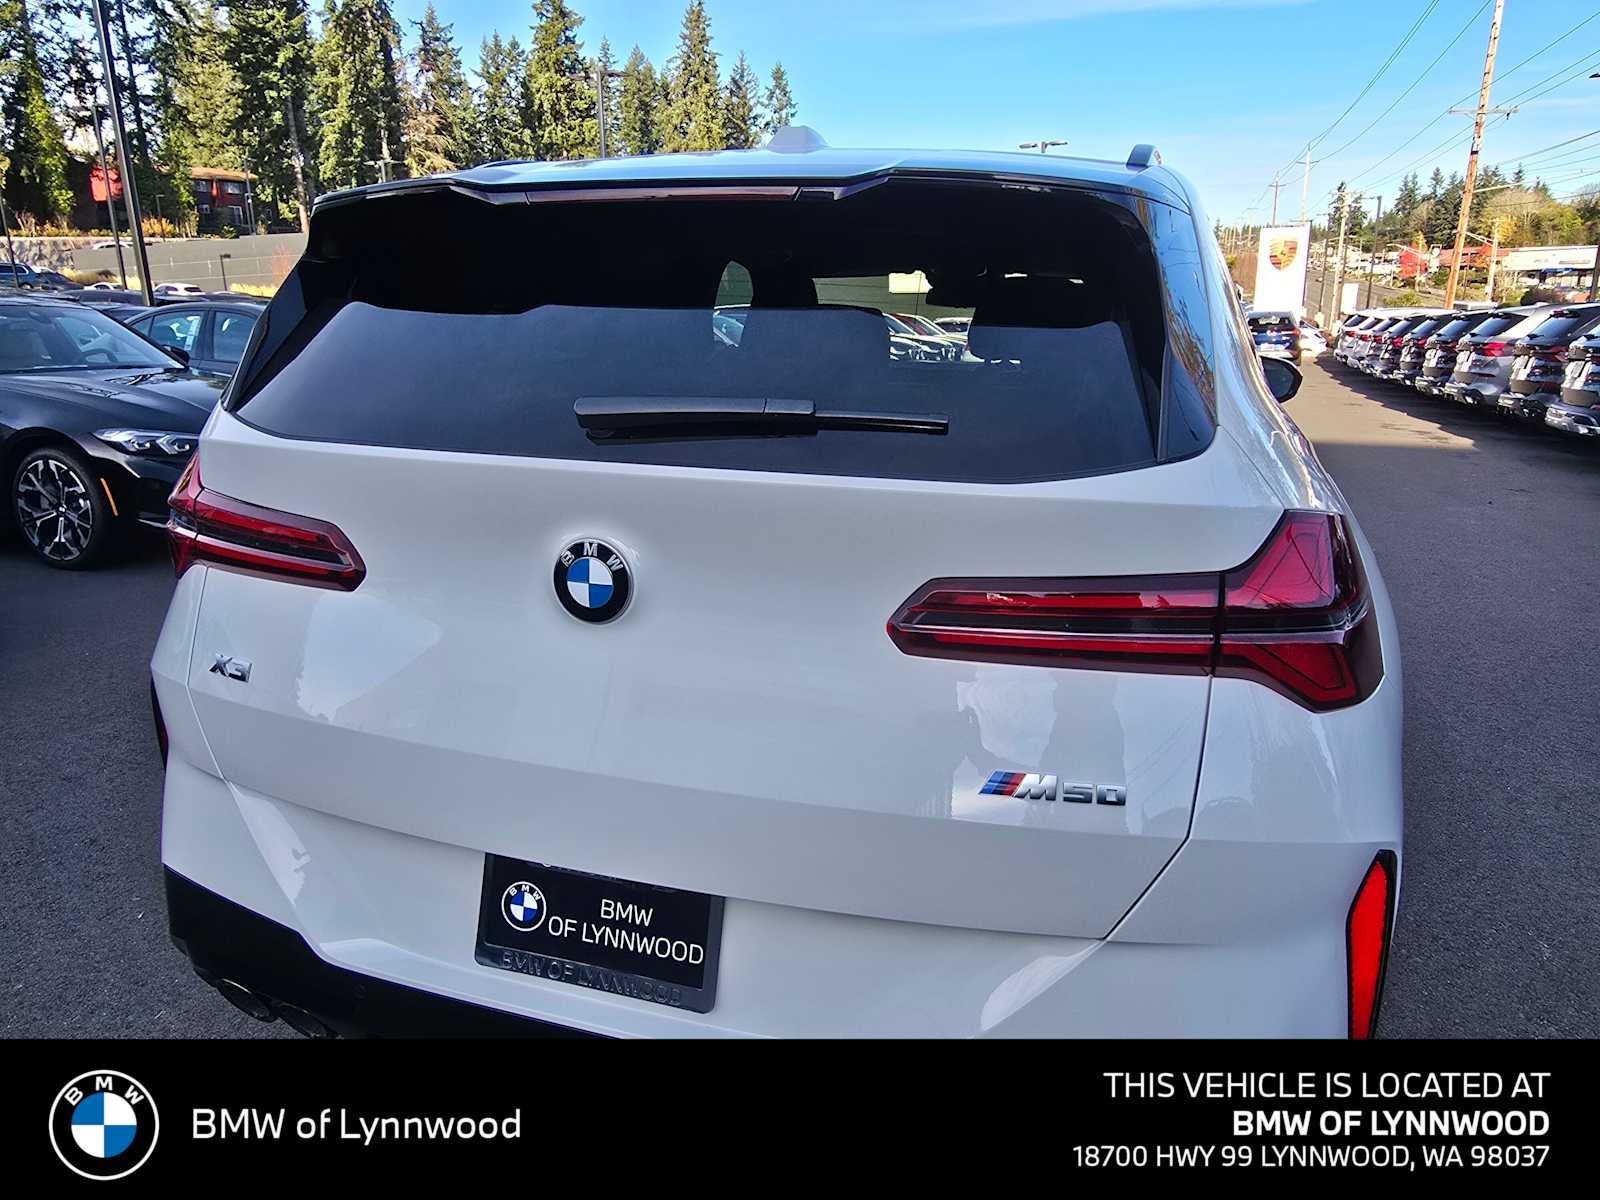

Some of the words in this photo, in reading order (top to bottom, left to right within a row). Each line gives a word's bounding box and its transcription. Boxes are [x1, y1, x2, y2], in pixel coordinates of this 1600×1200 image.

[560, 542, 624, 572] BMW
[209, 654, 252, 683] X3
[509, 884, 542, 901] BMW
[600, 898, 653, 927] BMW
[548, 916, 577, 938] OF
[582, 922, 704, 965] LYNNWOOD
[502, 950, 546, 976] BMW
[547, 961, 575, 981] OF
